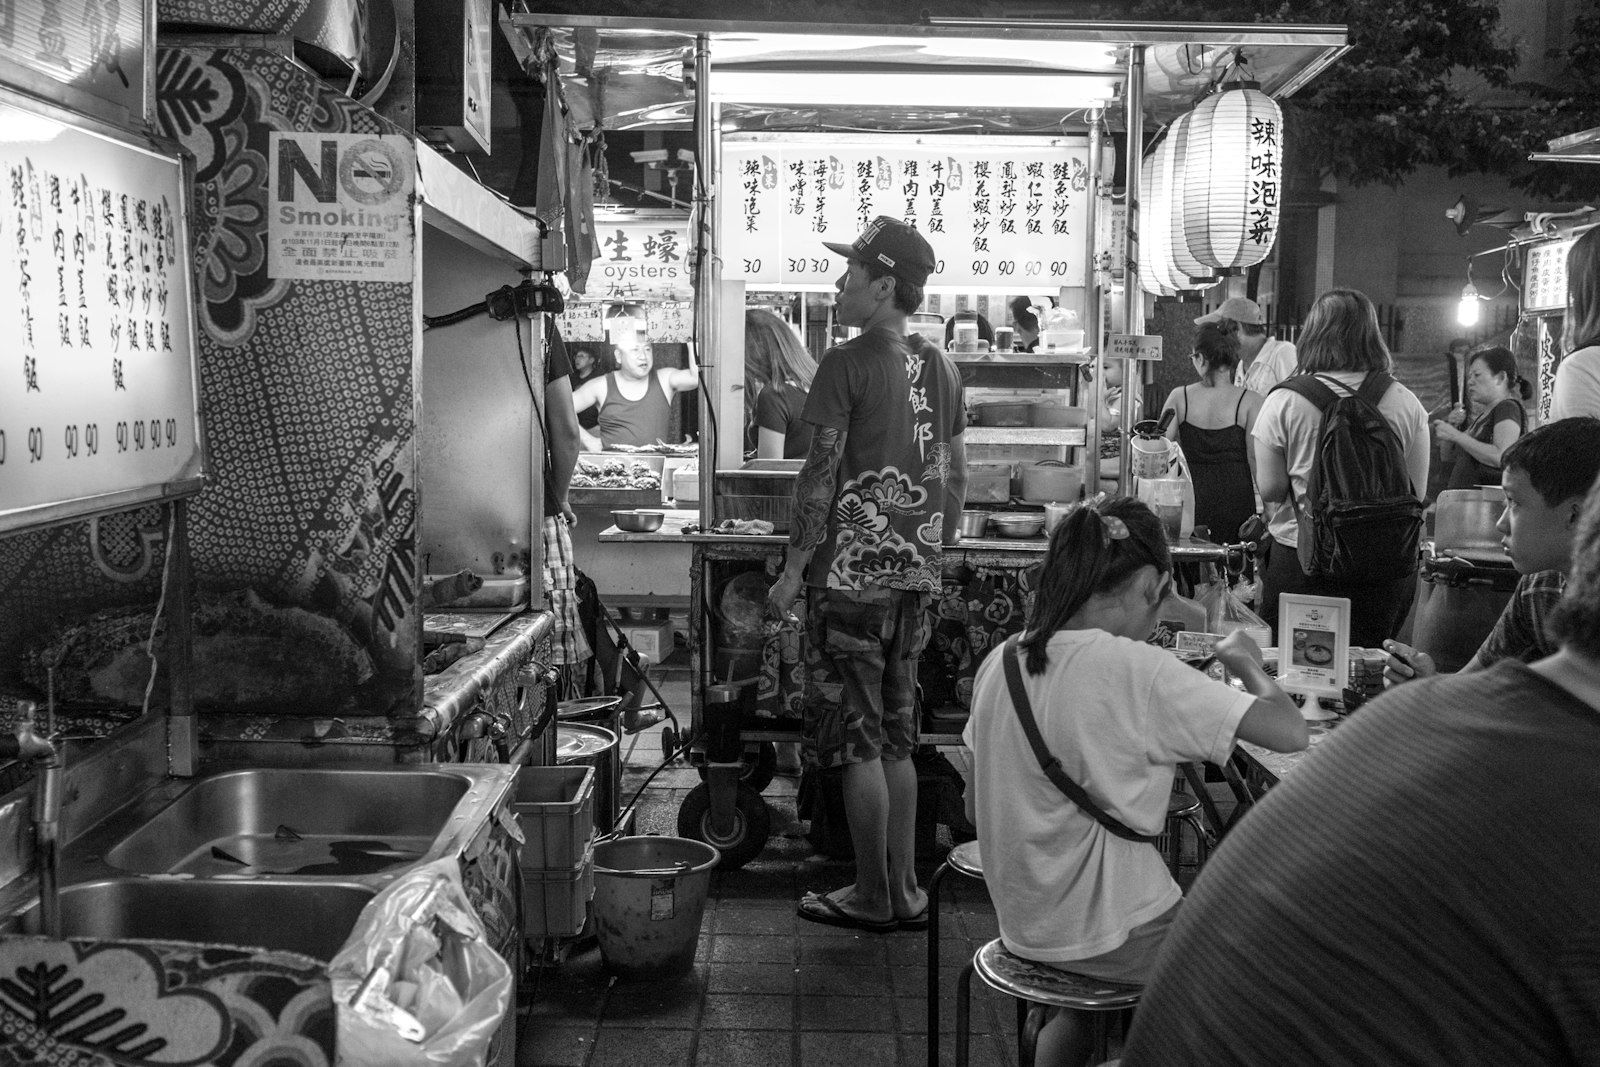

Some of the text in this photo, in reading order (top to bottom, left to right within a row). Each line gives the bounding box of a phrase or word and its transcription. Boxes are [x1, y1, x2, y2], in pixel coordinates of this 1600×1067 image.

[743, 160, 761, 234] 辣味泡菜
[789, 160, 807, 215] 味噌湯
[811, 160, 829, 234] 海帶芽湯
[928, 160, 946, 234] 牛肉蓋飯
[999, 161, 1017, 234] 鳳梨炒飯
[1026, 161, 1045, 235] 蝦仁炒飯
[1052, 161, 1070, 235] 鮭魚炒飯
[1249, 117, 1278, 245] 辣味泡菜
[280, 206, 399, 232] Smoking
[972, 161, 991, 253] 櫻花蝦炒飯
[604, 229, 680, 263] 生蠔
[604, 264, 677, 281] oysters
[743, 258, 761, 273] 30
[788, 258, 806, 273] 30
[810, 258, 829, 273] 30
[972, 260, 989, 275] 90
[998, 260, 1015, 275] 90
[1025, 261, 1042, 276] 90
[1050, 261, 1067, 276] 90
[905, 354, 933, 463] 炒飯郎
[28, 427, 43, 463] 90
[65, 424, 78, 459] 90
[85, 423, 98, 457] 90
[116, 421, 128, 453] 90
[134, 420, 145, 451] 90
[150, 419, 161, 449] 90
[165, 418, 177, 448] 90
